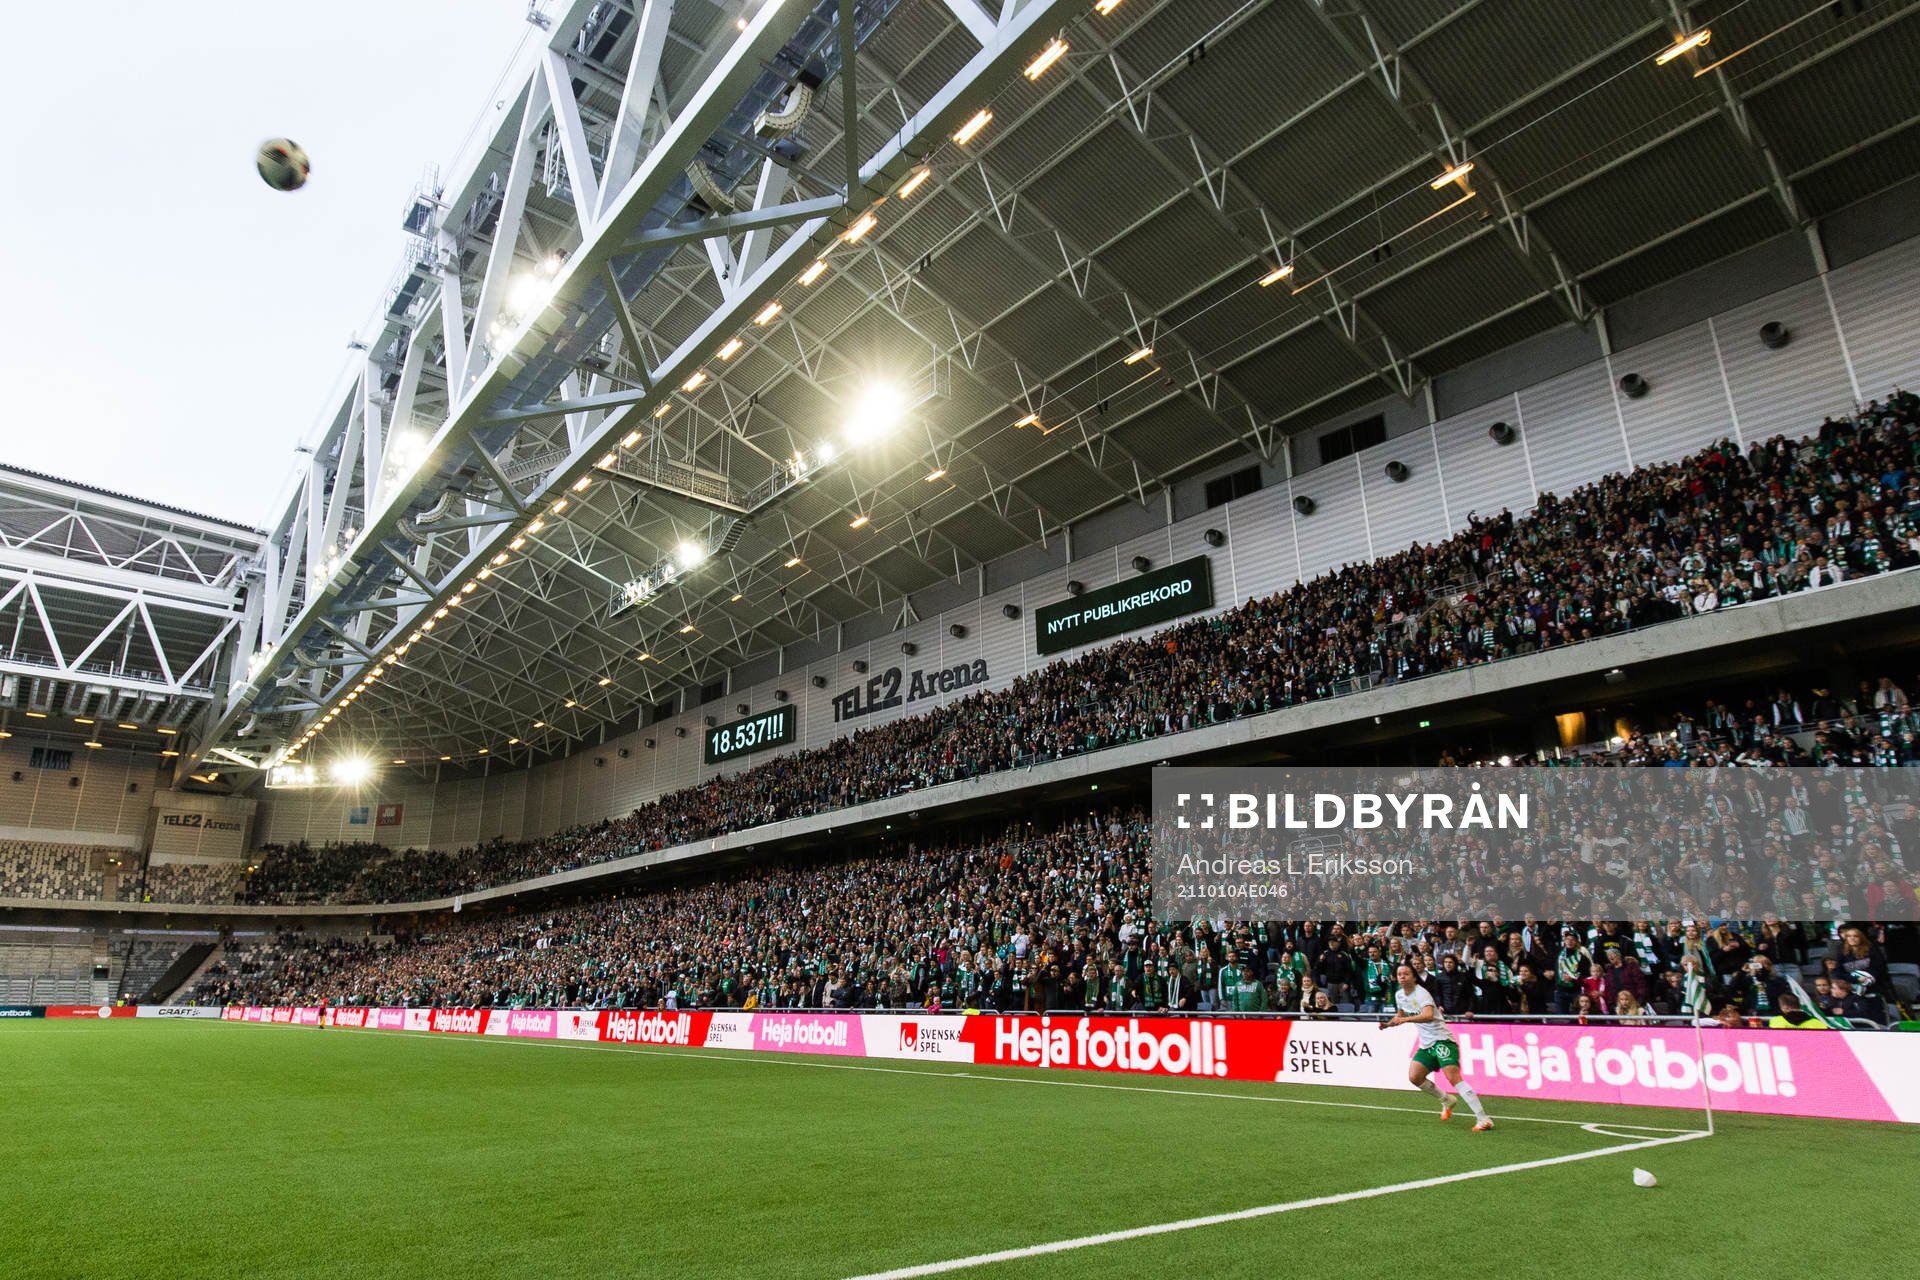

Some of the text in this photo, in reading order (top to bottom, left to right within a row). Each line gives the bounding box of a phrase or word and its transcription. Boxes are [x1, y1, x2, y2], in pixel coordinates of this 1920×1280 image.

[1047, 579, 1192, 634] NYTT PUBLIKREKORD
[831, 658, 990, 723] TELE2 Arena
[712, 712, 784, 756] 18.537!!!
[163, 814, 240, 831] TELE2 Arena
[0, 1009, 33, 1017] antbank
[158, 1008, 192, 1016] CRAFT
[606, 1011, 692, 1046] Heja fotboll!
[710, 1023, 737, 1033] SVENSKA
[761, 1018, 848, 1048] Heja fotboll!
[920, 1028, 961, 1042] SVENSKA
[709, 1033, 723, 1043] SPEL
[995, 1016, 1229, 1077] Heja fotboll!
[920, 1042, 942, 1054] SPEL
[1289, 1039, 1372, 1058] SVENSKA
[1290, 1058, 1333, 1075] SPEL
[1459, 1032, 1797, 1098] Heja fotboll!
